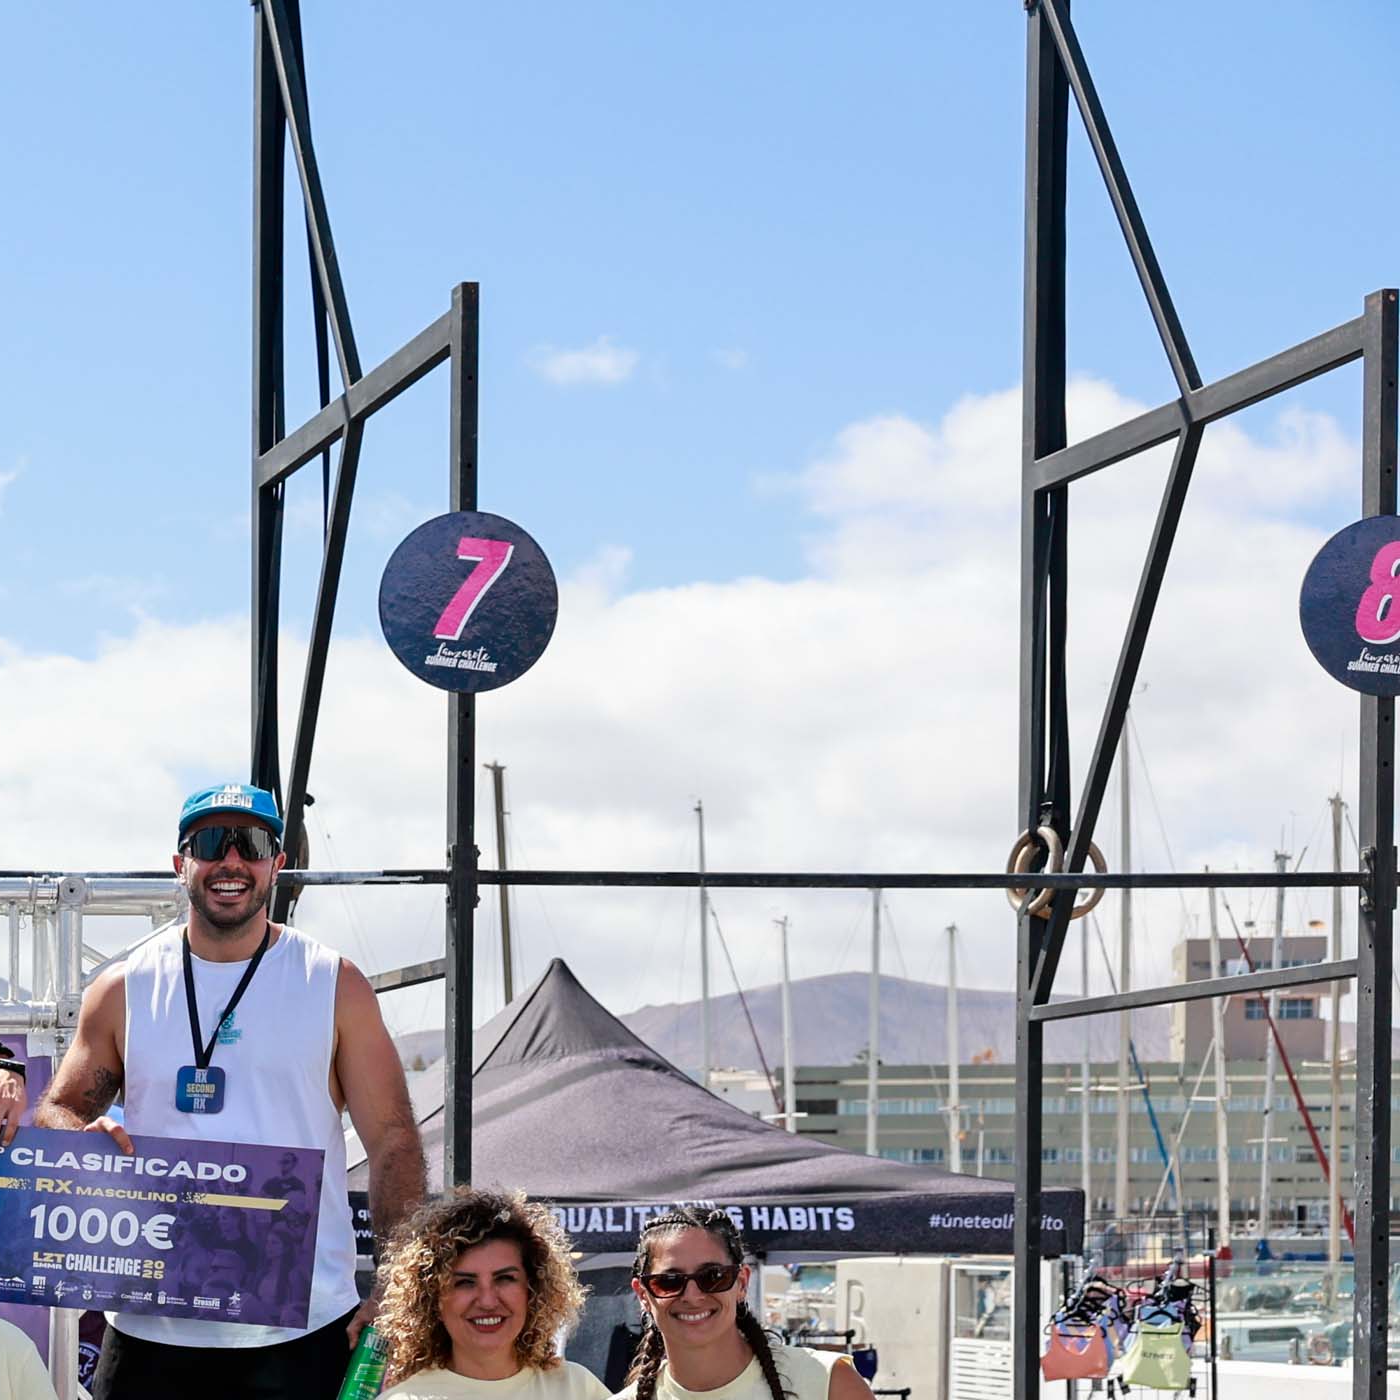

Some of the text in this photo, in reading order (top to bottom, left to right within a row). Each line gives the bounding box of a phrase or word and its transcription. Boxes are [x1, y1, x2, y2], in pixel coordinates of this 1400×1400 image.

[432, 536, 515, 641] 7
[1355, 540, 1400, 644] 8
[425, 655, 497, 672] SUMMER CHALLENGE
[1347, 661, 1380, 673] SUMMER
[186, 1083, 216, 1094] SECOND
[10, 1147, 247, 1183] CLASIFICADO
[35, 1177, 177, 1203] RX MASCULINO
[30, 1203, 176, 1250] 1000€
[751, 1206, 855, 1231] HABITS
[32, 1251, 165, 1276] LZT CHALLENGE 20
[32, 1261, 164, 1280] SMMR 25
